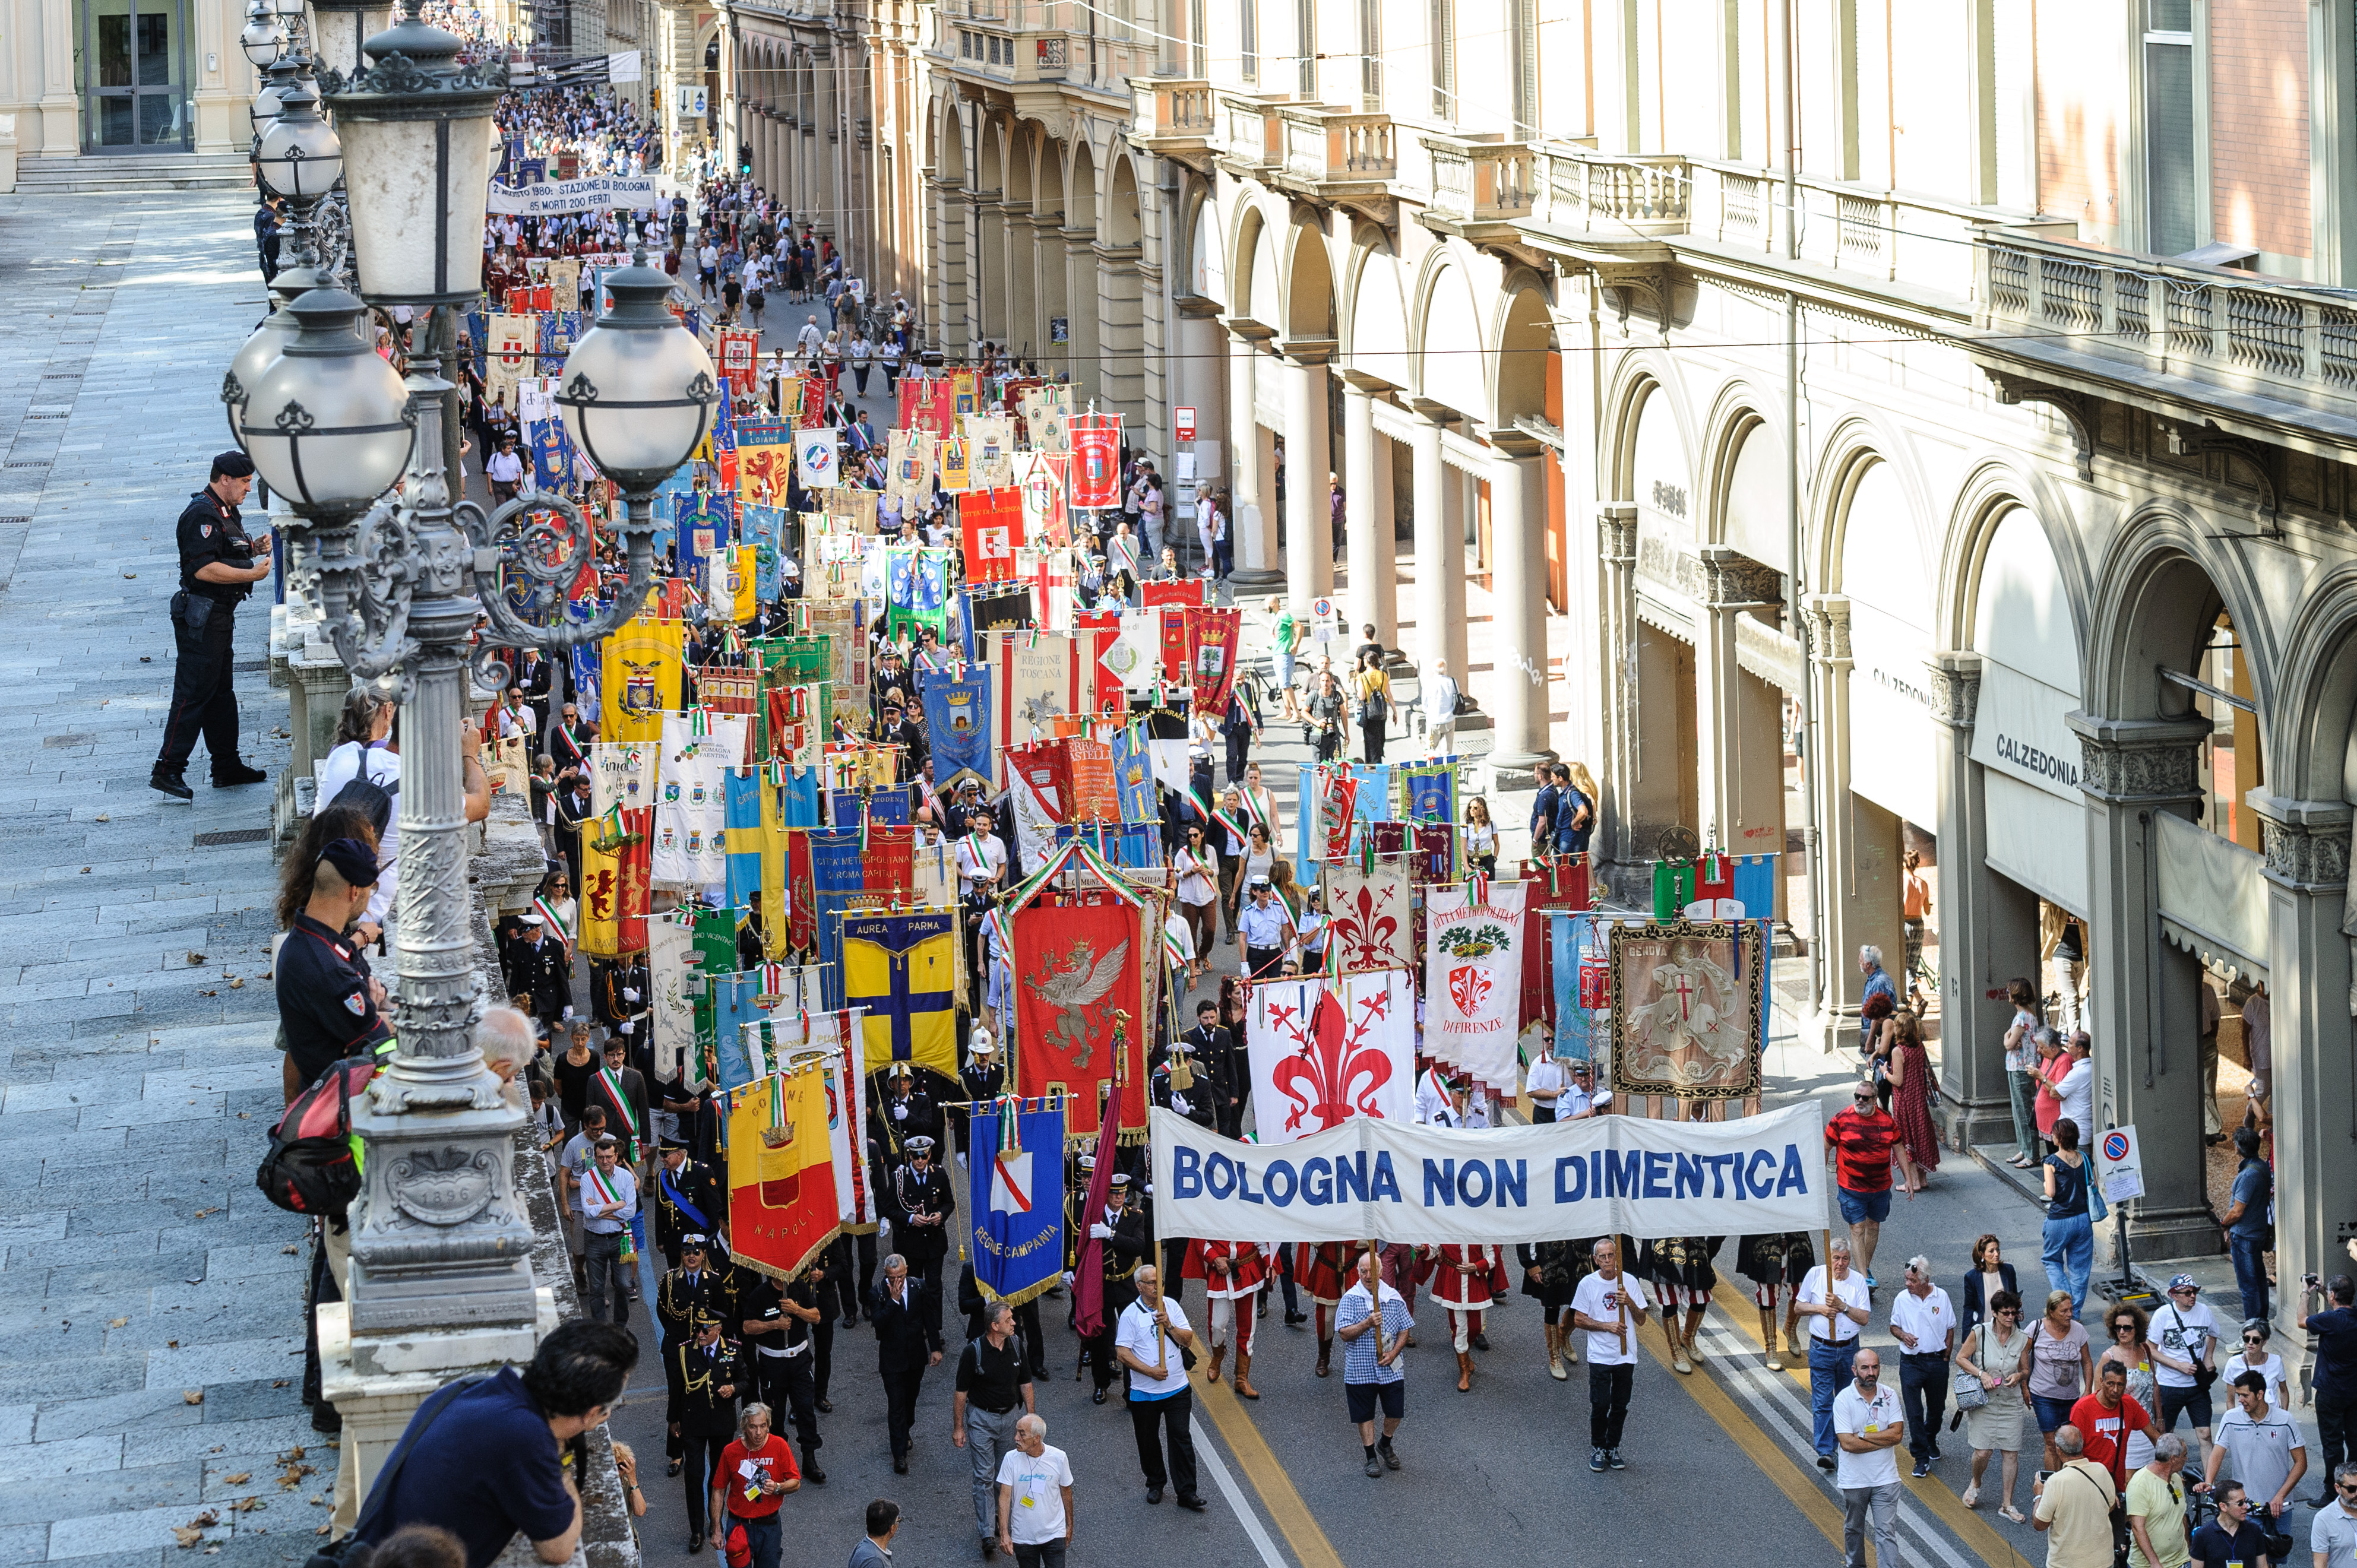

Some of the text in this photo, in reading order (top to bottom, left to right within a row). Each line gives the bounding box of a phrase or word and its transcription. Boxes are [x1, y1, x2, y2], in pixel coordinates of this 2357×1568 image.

[493, 184, 499, 194] 2
[533, 186, 553, 197] 1980:
[559, 179, 600, 195] STAZIONE
[602, 179, 610, 190] DI
[613, 181, 651, 192] BOLOGNA
[530, 201, 539, 211] 85
[542, 199, 566, 210] MORTI
[570, 197, 586, 208] 200
[586, 255, 631, 265] CIAZINE
[1080, 435, 1102, 444] COMUNE
[708, 506, 727, 522] RAVENNA
[1048, 518, 1065, 533] RBINO
[1211, 617, 1238, 633] MARANELLO
[765, 644, 816, 654] REGIONE LOMBARDIA
[1021, 654, 1061, 665] REGIONE
[1021, 667, 1061, 679] TOSCANA
[1874, 667, 1930, 706] CALZEDONI
[772, 696, 789, 709] COMUN
[1157, 708, 1186, 723] FERRARA
[1069, 741, 1096, 753] ERRE
[1070, 750, 1111, 762] ASTELLI
[1997, 733, 2078, 788] CALZEDONIA
[606, 762, 642, 772] unioe
[737, 790, 760, 805] CITTA
[817, 856, 910, 866] CITTA' METROPOLITANA
[828, 869, 900, 879] DI ROMA CAPITALE
[1072, 877, 1100, 885] CMUNE
[1327, 871, 1347, 886] COMUNE
[1014, 880, 1045, 912] AUGUSTA
[1108, 879, 1135, 904] PERUGIA
[1539, 884, 1573, 895] CONE
[1456, 905, 1519, 928] METROPOLITANA
[857, 921, 940, 935] AUREA PARMA
[594, 935, 640, 948] RAVENNA
[653, 936, 675, 954] COMUNE
[707, 933, 734, 947] VICENTINO
[1628, 945, 1668, 956] GENOVA
[1443, 1016, 1505, 1034] DI FIRENZE
[765, 1034, 851, 1061] RGIONE PUGIA
[752, 1089, 803, 1117] CONE
[1173, 1143, 1808, 1208] BOLOGNA NON DIMENTICA
[422, 1187, 469, 1205] 1896
[754, 1209, 814, 1240] NAPOLI
[975, 1224, 1059, 1259] REGINE CAMPANIA
